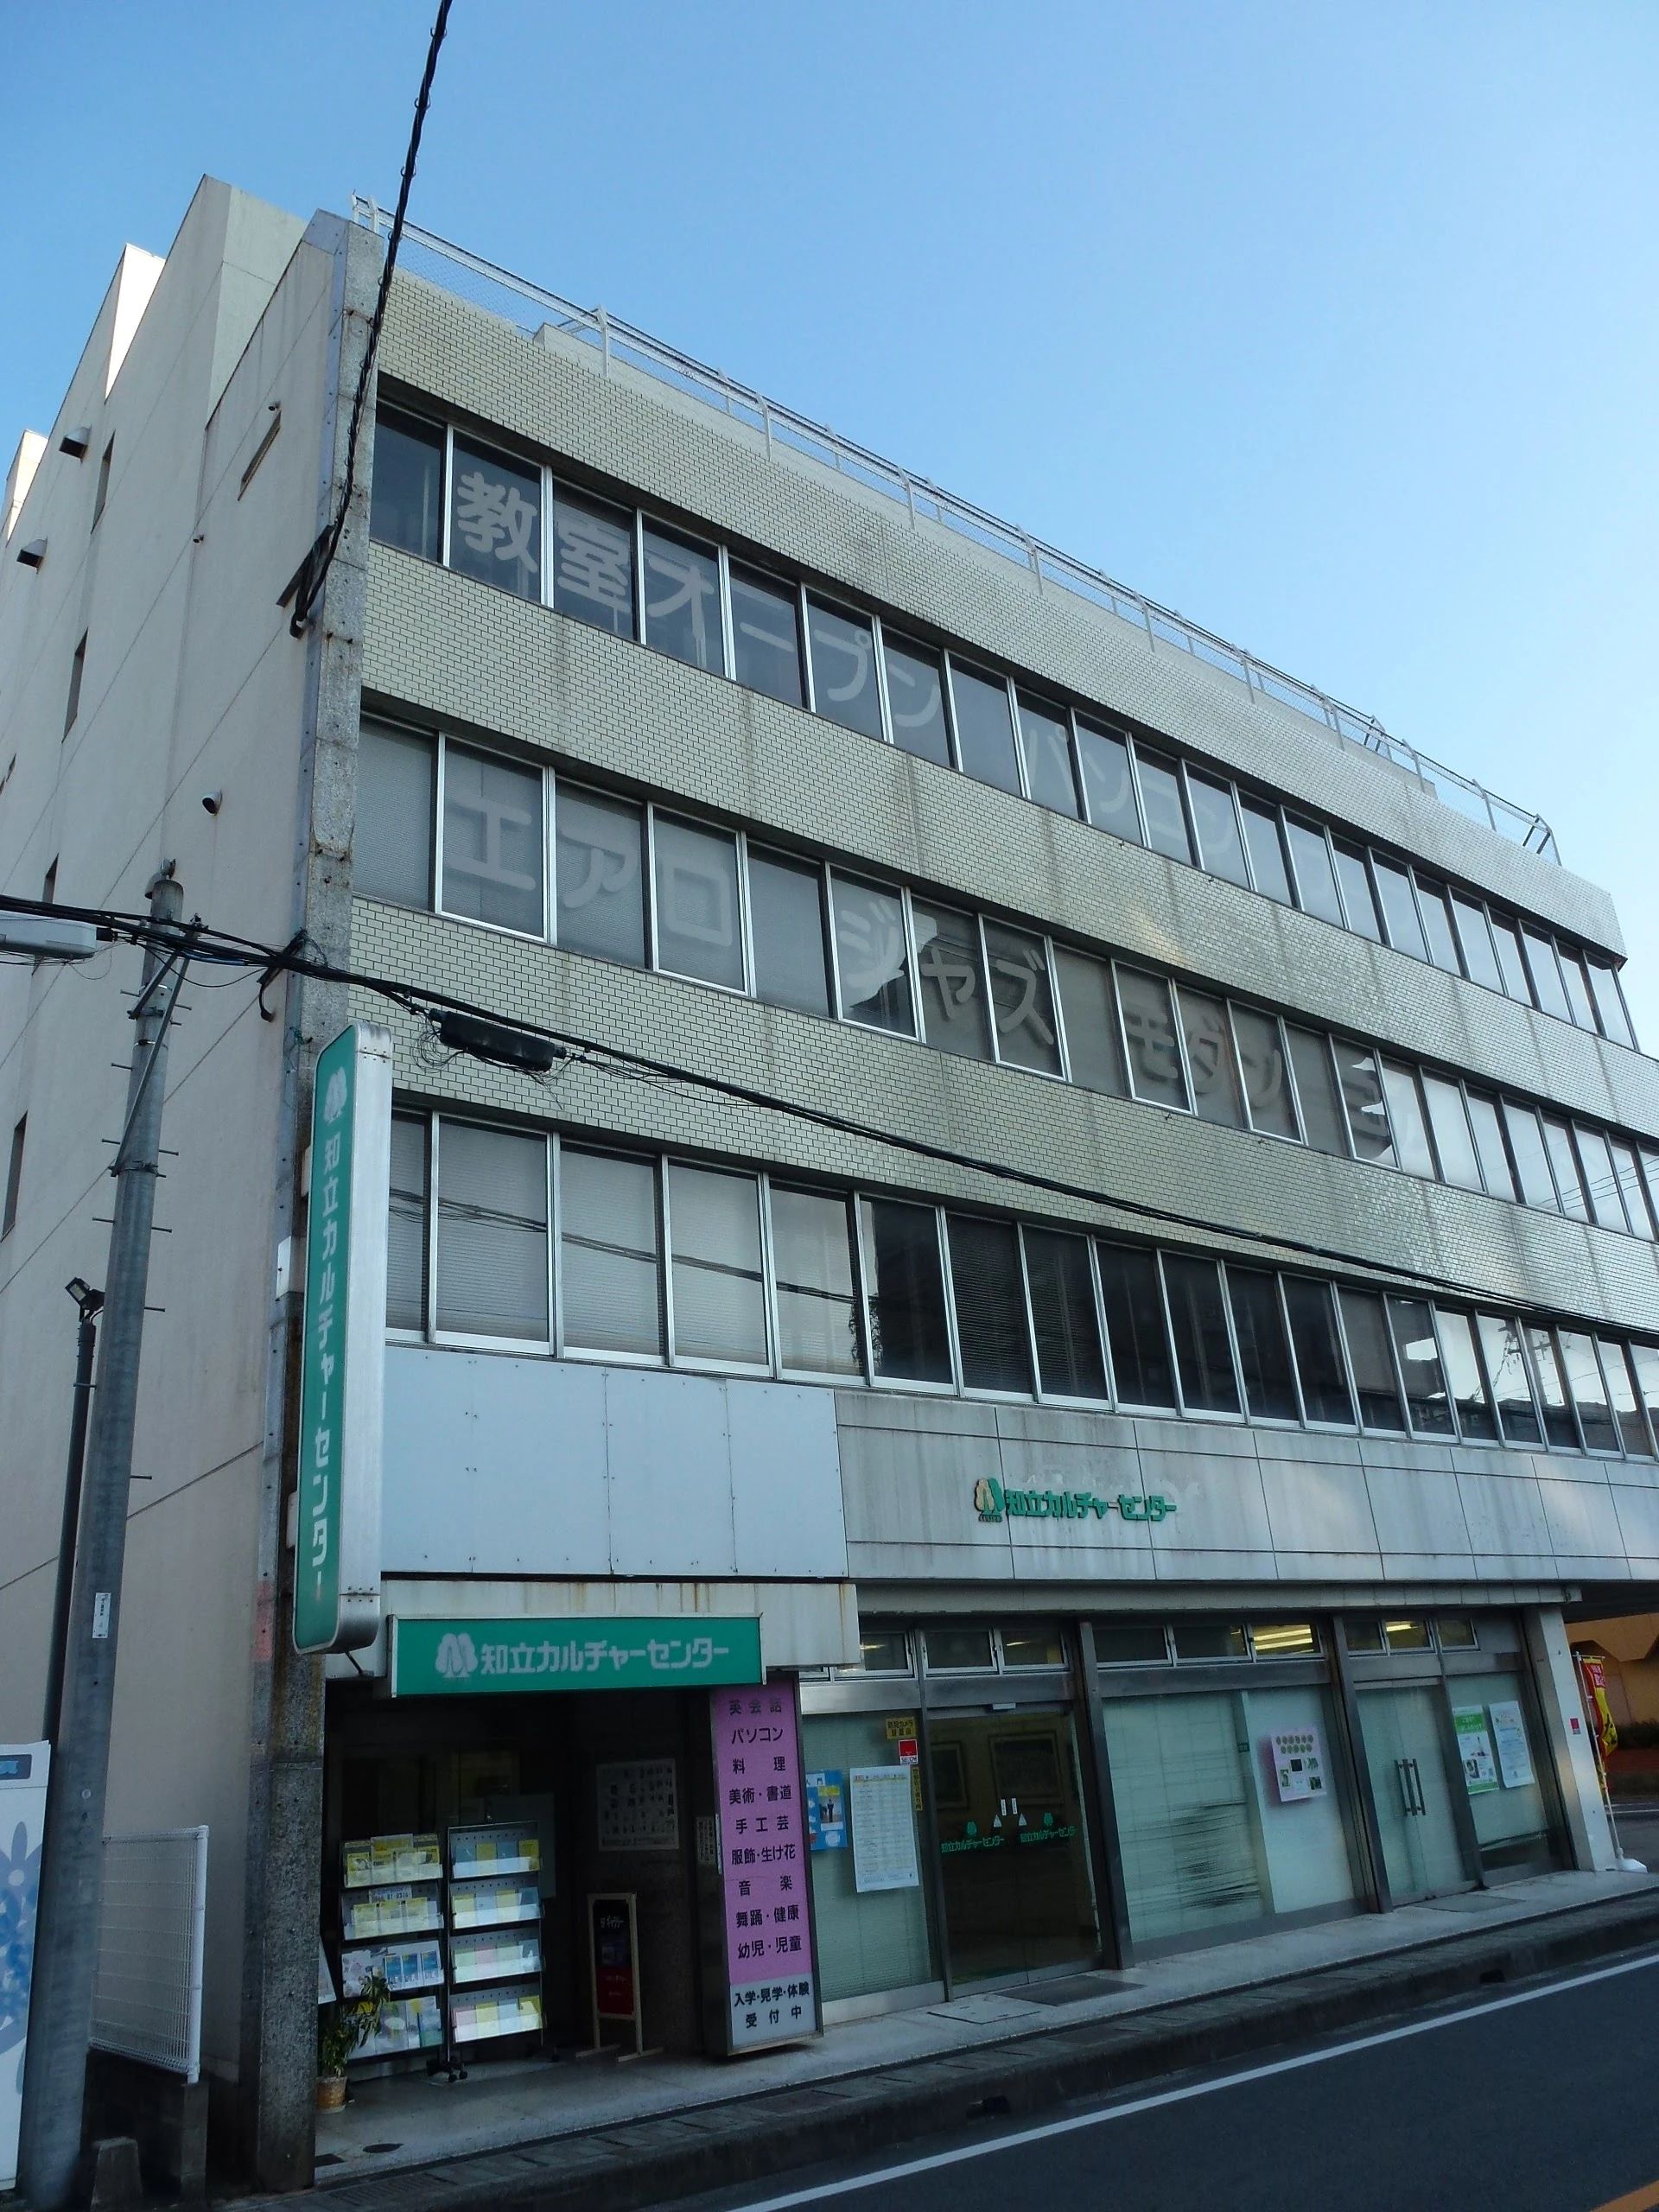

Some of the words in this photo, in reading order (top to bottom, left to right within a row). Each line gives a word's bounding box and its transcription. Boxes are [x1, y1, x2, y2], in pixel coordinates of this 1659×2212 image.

[312, 1130, 341, 1600] 知立カルチャーセンター
[1006, 1489, 1178, 1522] 知立カルチャーセンター
[480, 1637, 729, 1675] 知立カルチャーセンター
[729, 1698, 782, 1716] 英会話
[731, 1727, 784, 1745] パソコン
[728, 1784, 792, 1805] 美術・書道
[735, 1815, 789, 1835] 手工芸
[731, 1844, 796, 1866] 服飾・生け花
[735, 1904, 800, 1929] 舞踊・健康
[737, 1936, 803, 1960] 幼児・児童
[734, 1980, 810, 2007] 入学・見学・体験
[746, 2005, 803, 2029] 受付中
